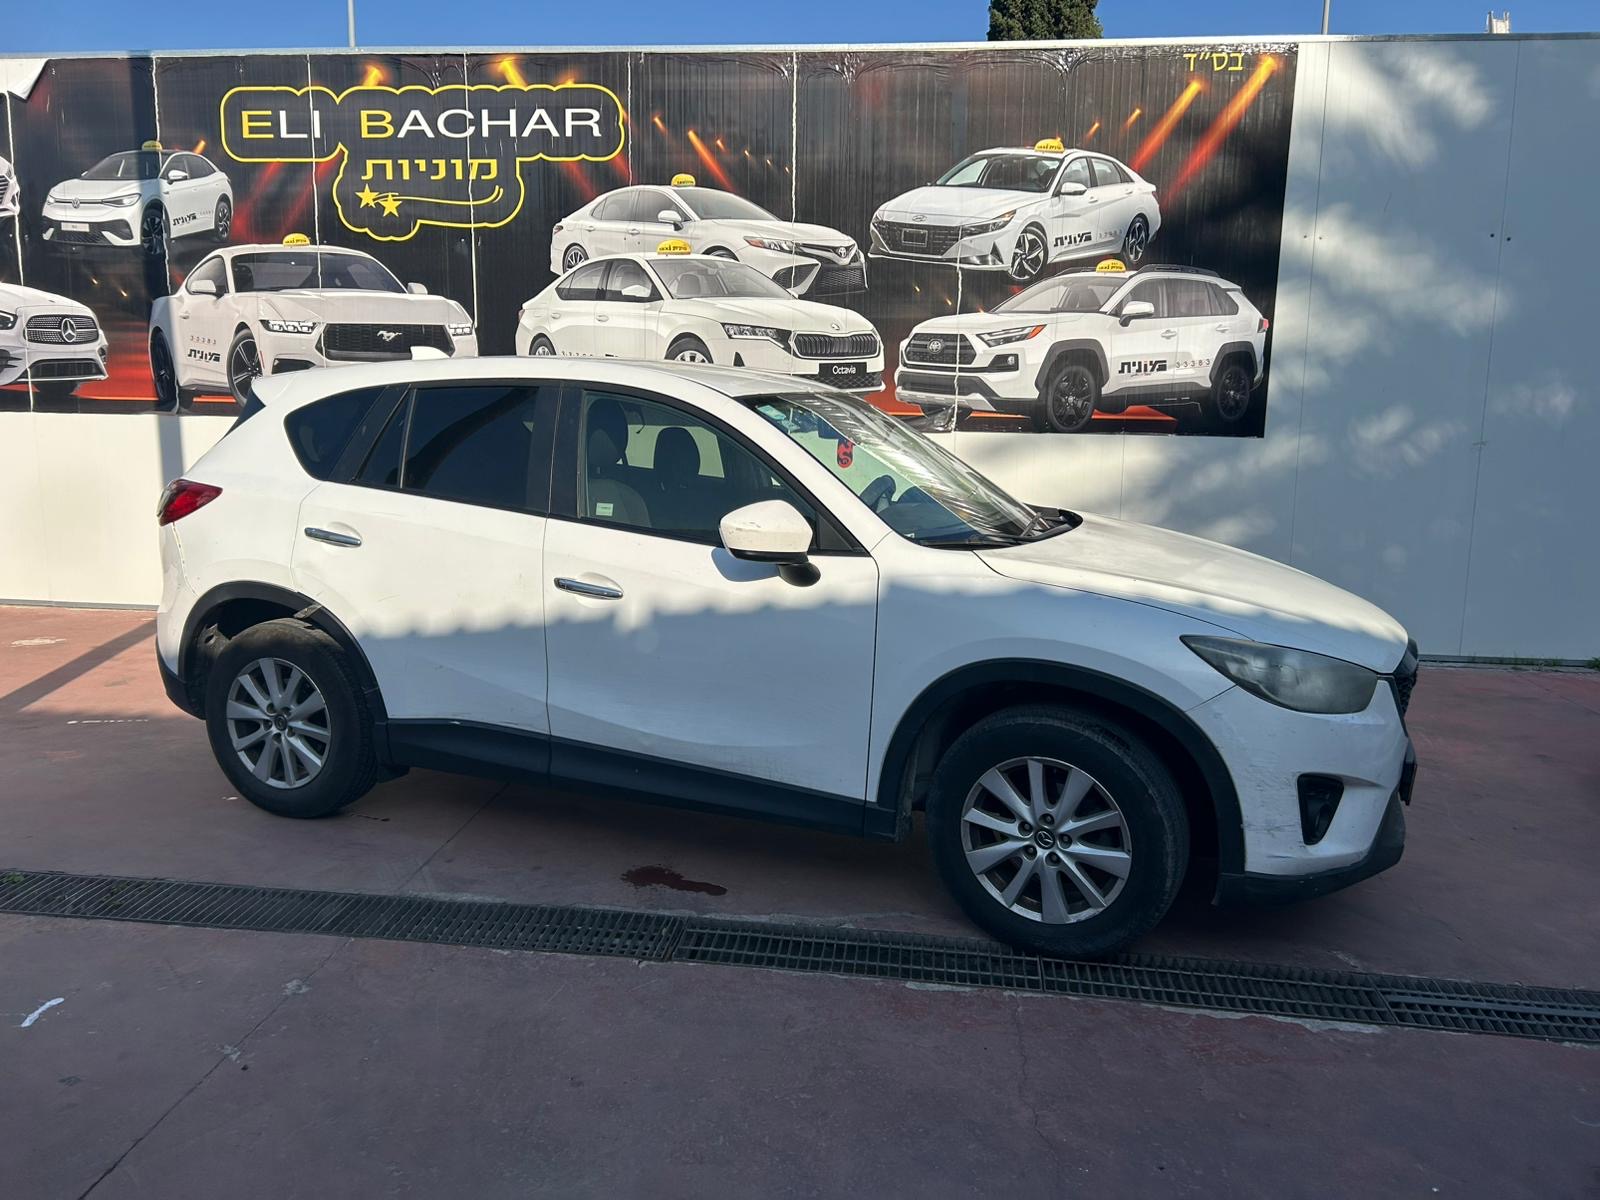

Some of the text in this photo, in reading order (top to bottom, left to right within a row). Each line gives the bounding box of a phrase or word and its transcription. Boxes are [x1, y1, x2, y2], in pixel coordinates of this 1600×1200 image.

[241, 108, 602, 139] ELI BACHAR
[361, 159, 498, 180] מוניות
[832, 364, 857, 375] Octavia
